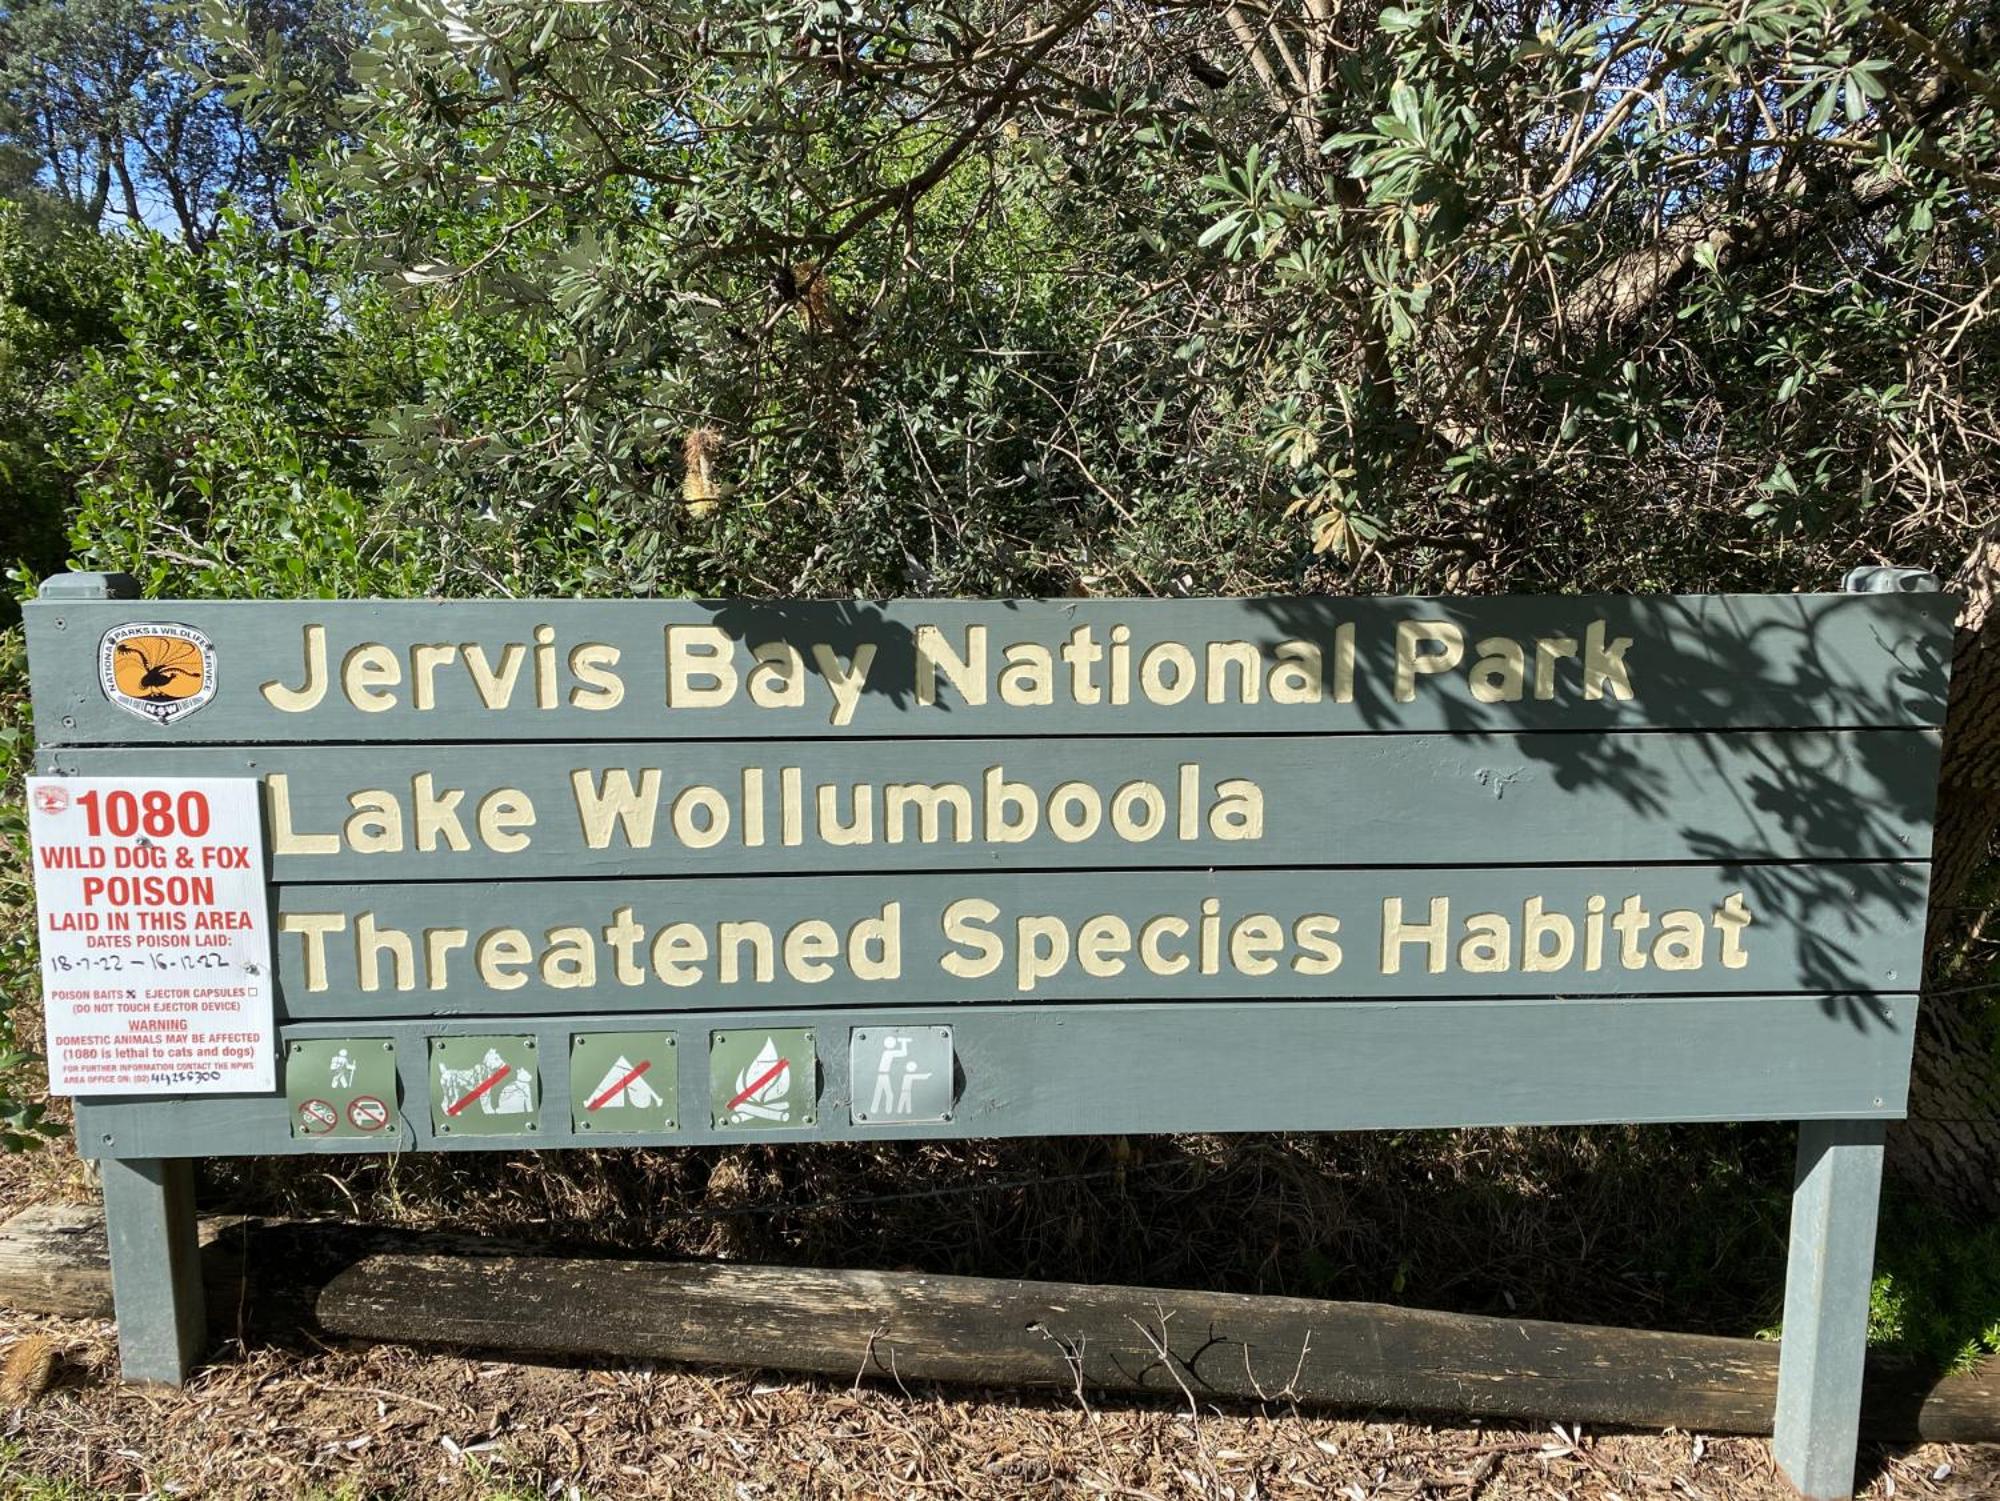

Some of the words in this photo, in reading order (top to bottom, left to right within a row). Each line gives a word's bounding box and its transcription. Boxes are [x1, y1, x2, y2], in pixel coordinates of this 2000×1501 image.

[115, 626, 150, 640] PARKS
[160, 627, 206, 647] WILDLIFE
[104, 638, 117, 692] NATIONA
[204, 645, 213, 691] ERVICE
[260, 624, 625, 712] Jervis
[665, 624, 877, 726] Bay
[916, 623, 1355, 706] National
[1394, 620, 1635, 703] Park
[145, 703, 178, 716] NSW
[76, 790, 210, 837] 1080
[266, 771, 536, 854] Lake
[571, 763, 1264, 849] Wollumboola
[40, 847, 106, 868] WILD
[115, 846, 167, 868] DOG
[175, 846, 194, 868] &
[202, 846, 250, 868] FOX
[83, 876, 215, 906] POISON
[49, 913, 99, 931] LAID
[108, 912, 129, 931] IN
[137, 911, 187, 931] THIS
[195, 911, 253, 930] AREA
[87, 935, 131, 948] DATES
[137, 934, 190, 948] POISON
[195, 934, 232, 947] LAID:
[279, 901, 901, 992] Threatened
[940, 898, 1342, 991] Species
[1380, 892, 1752, 974] Habitat
[51, 990, 90, 1000] POISON
[93, 989, 124, 1000] BAITS
[145, 988, 190, 999] EJECTOR
[193, 987, 246, 998] CAPSULES
[72, 1003, 91, 1015] (DO
[94, 1003, 113, 1013] NOT
[116, 1003, 150, 1013] TOUCH
[153, 1002, 199, 1012] EJECTOR
[201, 1001, 241, 1012] DEVICE)
[128, 1019, 188, 1031] WARNING
[55, 1036, 111, 1046] DOMESTIC
[114, 1035, 162, 1045] ANIMALS
[165, 1034, 188, 1044] MAY
[191, 1033, 206, 1043] BE
[209, 1032, 260, 1043] AFFECTED
[63, 1048, 97, 1061] (1080
[101, 1047, 112, 1058] is
[115, 1047, 149, 1058] lethal
[152, 1047, 165, 1058] to
[168, 1046, 193, 1057] cats
[197, 1046, 219, 1056] and
[222, 1045, 255, 1059] dogs)
[63, 1064, 79, 1072] FOR
[81, 1064, 117, 1072] FURTHER
[119, 1063, 174, 1072] INFORMATION
[176, 1062, 211, 1071] CONTACT
[214, 1062, 228, 1070] THE
[64, 1076, 85, 1084] AREA
[88, 1075, 115, 1084] OFFICE
